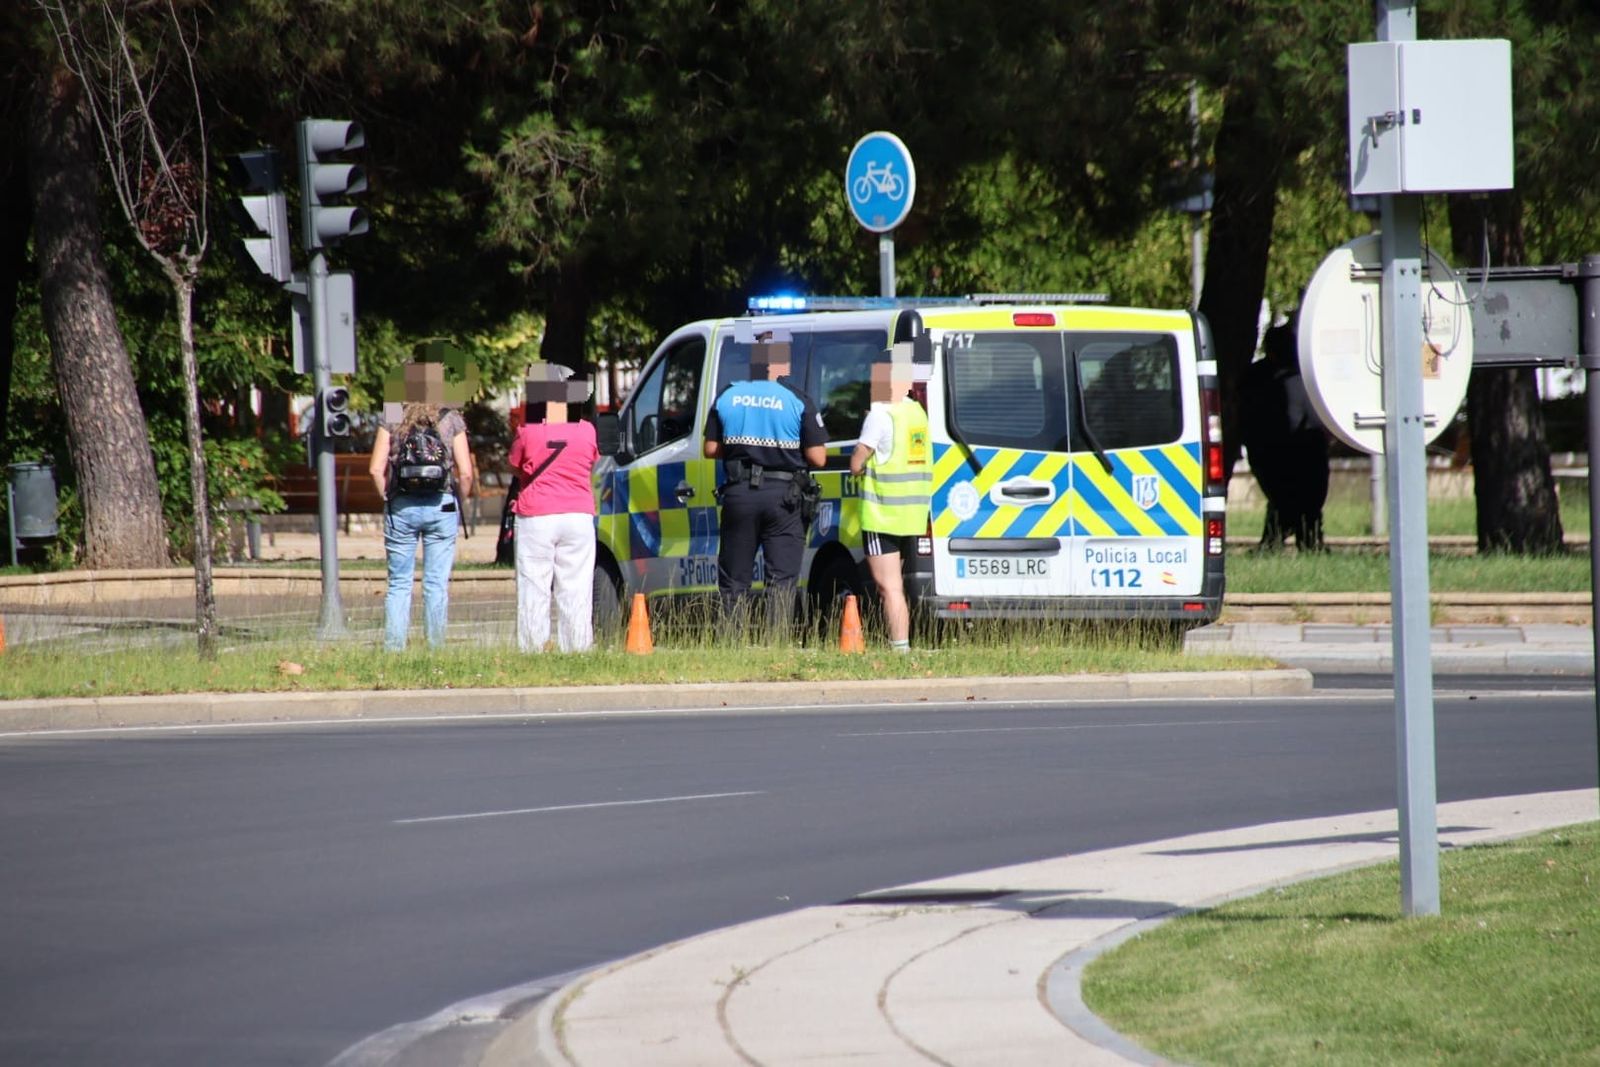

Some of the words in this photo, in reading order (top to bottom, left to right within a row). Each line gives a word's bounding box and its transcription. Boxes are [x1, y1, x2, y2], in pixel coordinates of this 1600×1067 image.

[945, 334, 974, 348] 717
[732, 395, 784, 411] POLICÍA
[1147, 548, 1187, 563] Local
[688, 558, 717, 584] Polic
[968, 559, 1010, 575] 5569
[1016, 559, 1047, 575] LRC
[1099, 569, 1142, 587] 112
